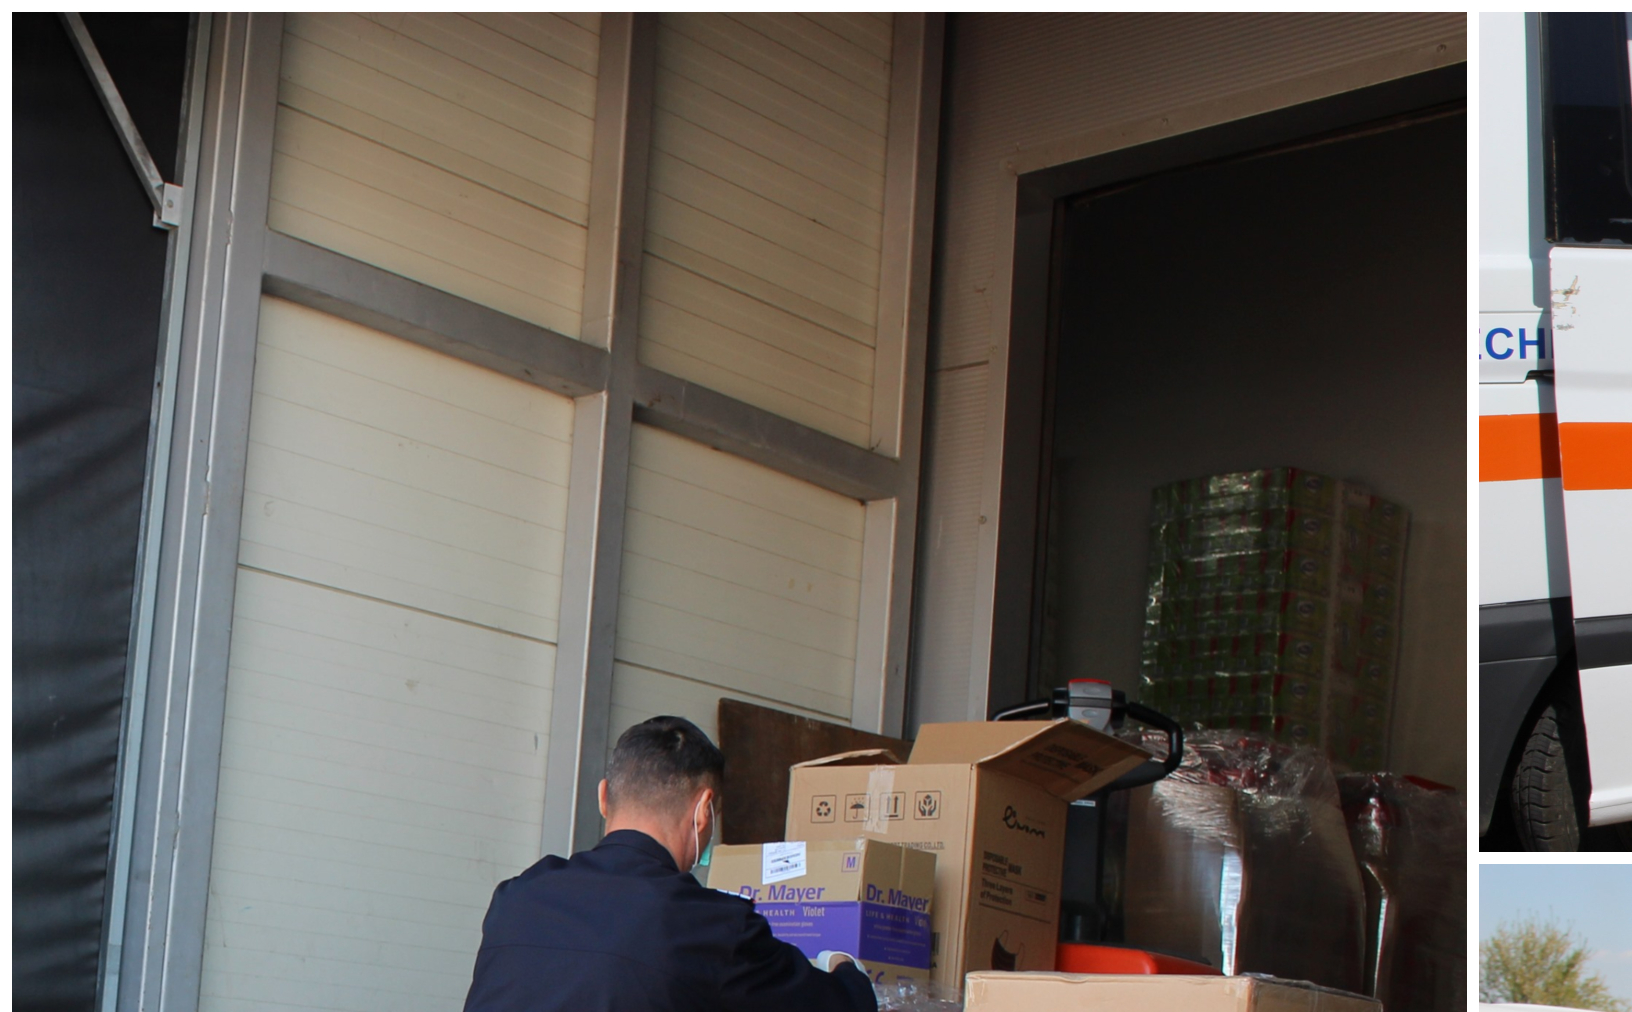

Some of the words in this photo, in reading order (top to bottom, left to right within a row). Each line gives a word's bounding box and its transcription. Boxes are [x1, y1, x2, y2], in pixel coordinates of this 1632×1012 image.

[1479, 327, 1554, 360] CH
[846, 856, 856, 868] M
[739, 885, 762, 901] Dr.
[768, 884, 825, 906] Mayer
[866, 884, 884, 903] Dr.
[888, 890, 929, 912] Mayer
[763, 909, 795, 917] HEALTH
[803, 906, 825, 917] Violet
